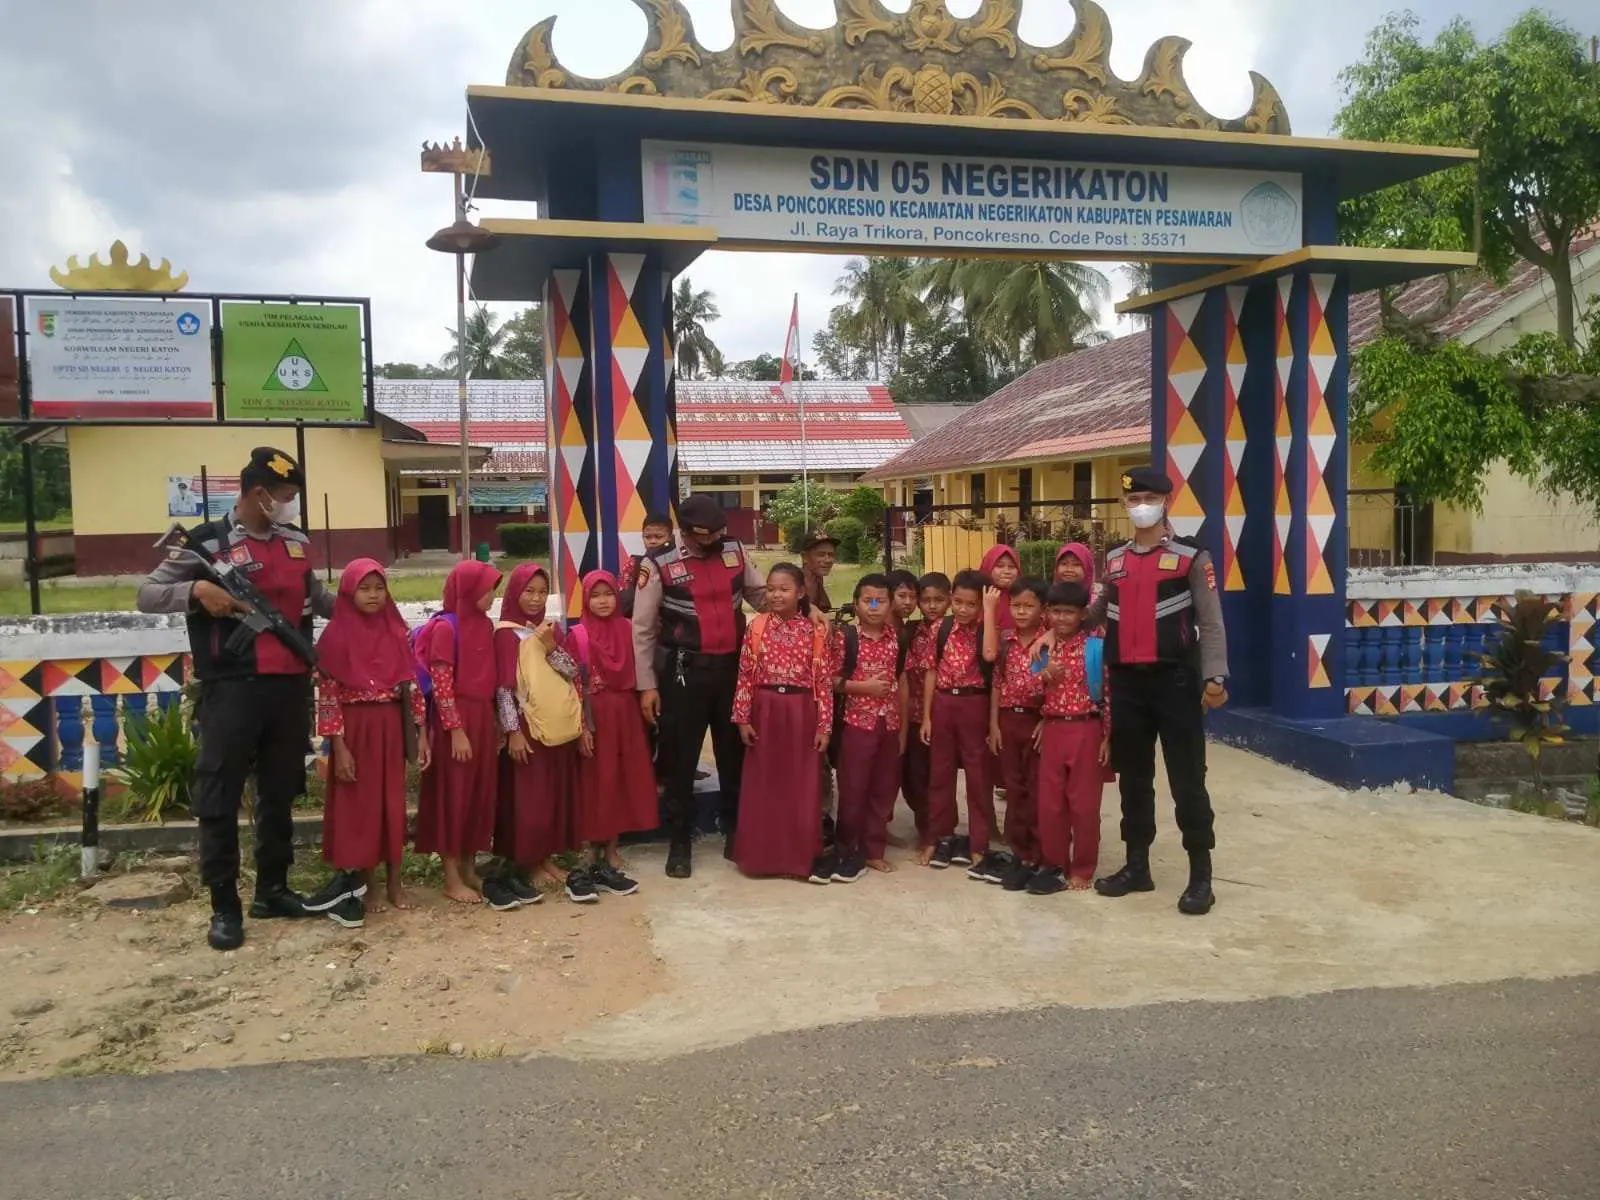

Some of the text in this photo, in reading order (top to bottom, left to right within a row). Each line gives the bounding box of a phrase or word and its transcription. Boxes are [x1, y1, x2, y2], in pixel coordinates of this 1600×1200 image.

[809, 155, 1169, 203] SDN 05 NEGERIKATON
[734, 193, 1232, 228] DESA PONCOKRESNO KECAMATAN NEGERIKATON KABUPATEN PESAWARAN
[790, 221, 811, 236] Jl.
[817, 222, 859, 241] Raya
[863, 224, 928, 242] Trikora,
[934, 226, 1044, 244] Poncokresno.
[1050, 230, 1090, 245] Code
[1096, 231, 1128, 246] Post
[1141, 232, 1186, 247] 35371
[291, 358, 299, 366] U
[292, 379, 299, 388] S
